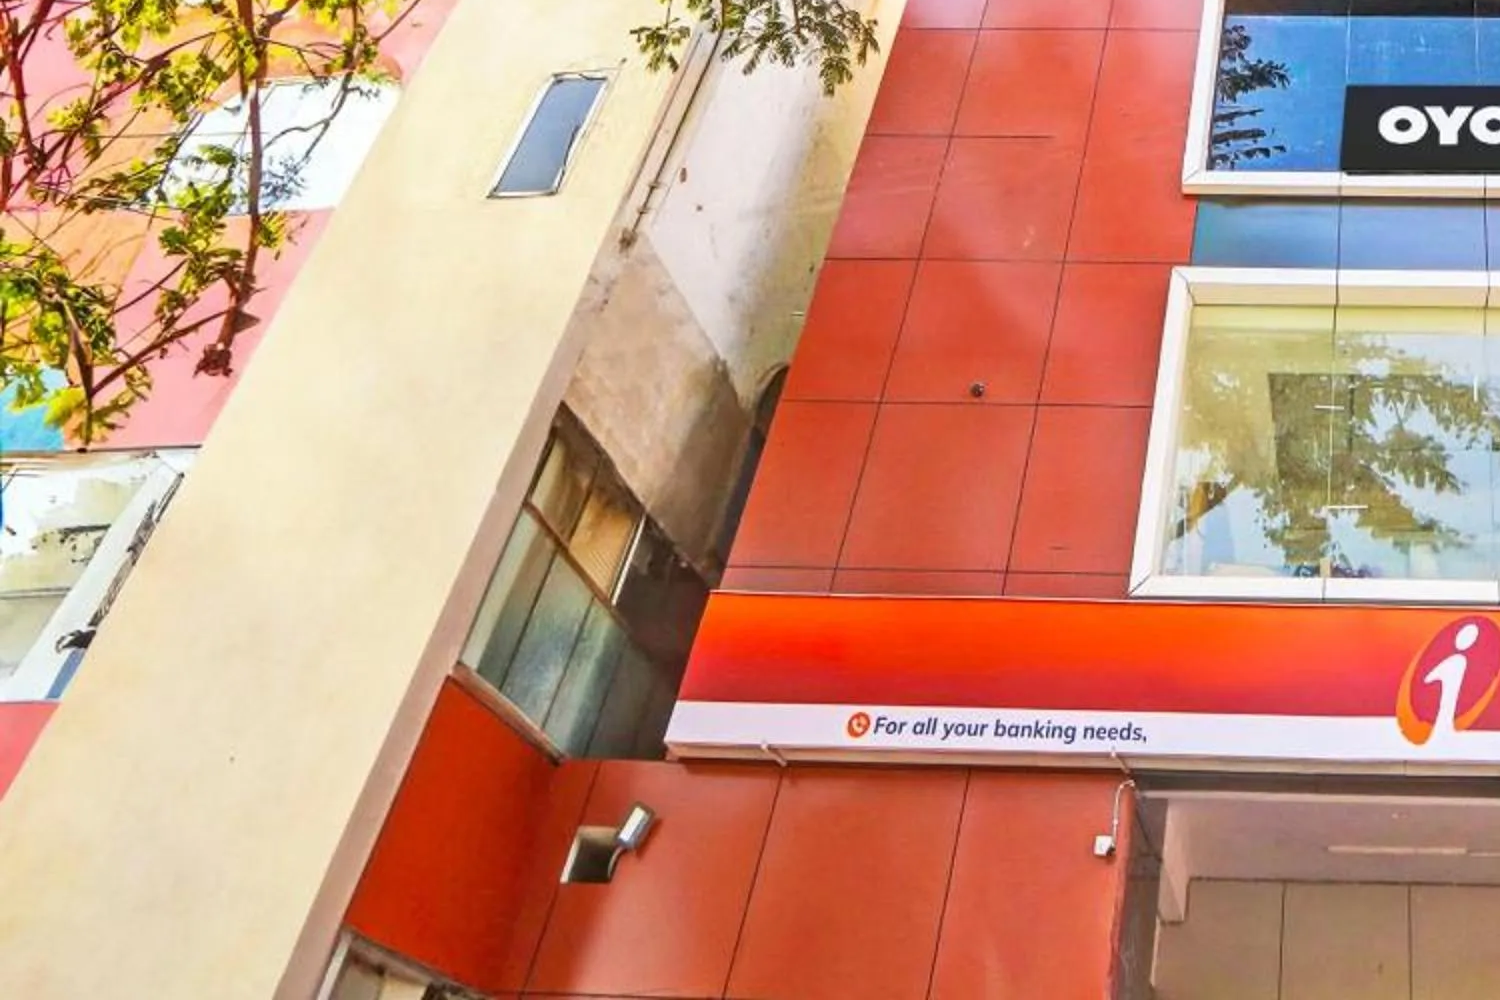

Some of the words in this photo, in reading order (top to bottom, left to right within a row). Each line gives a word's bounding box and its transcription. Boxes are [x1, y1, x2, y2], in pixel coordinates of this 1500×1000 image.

[872, 716, 906, 736] For
[911, 716, 937, 737] all
[941, 722, 988, 741] your
[993, 719, 1076, 745] banking
[1082, 720, 1147, 743] needs,
